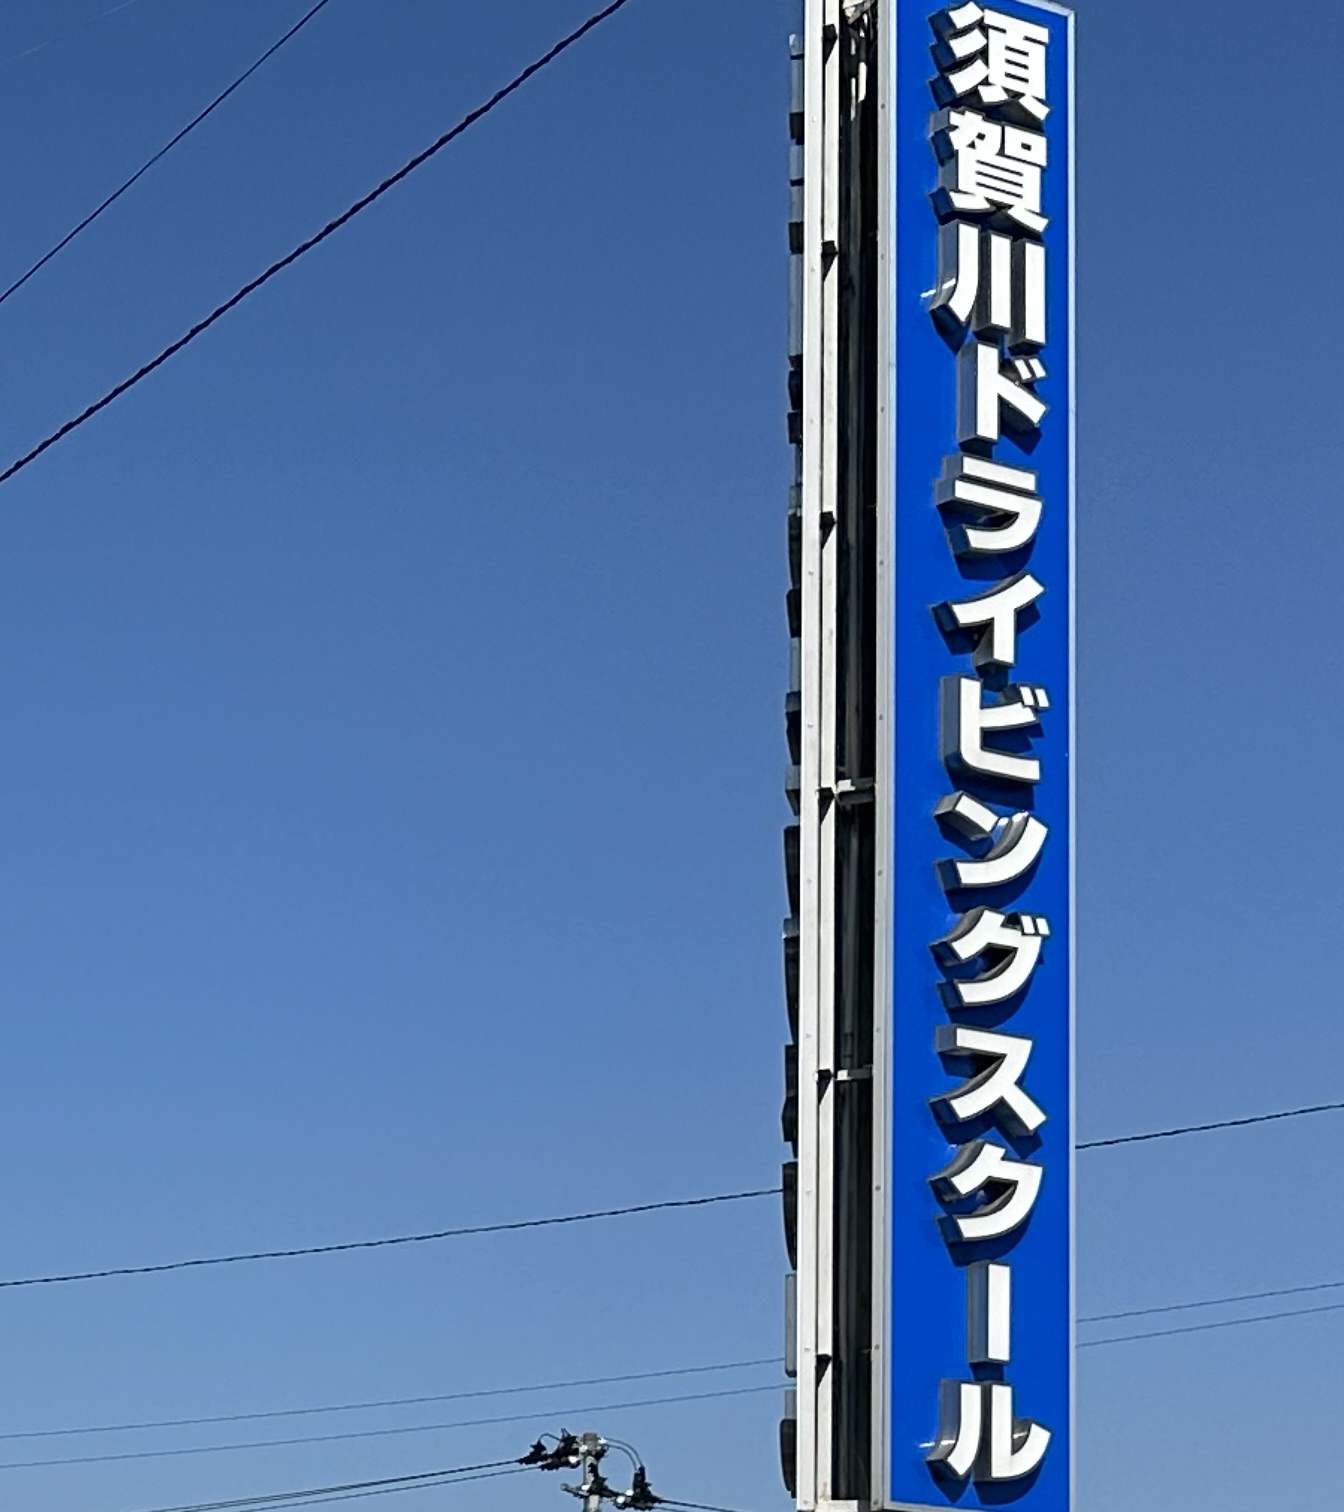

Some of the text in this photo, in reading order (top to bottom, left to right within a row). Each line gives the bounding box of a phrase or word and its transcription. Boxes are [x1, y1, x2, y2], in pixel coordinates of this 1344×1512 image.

[944, 0, 1052, 1480] 須賀川ドライビングスクール
